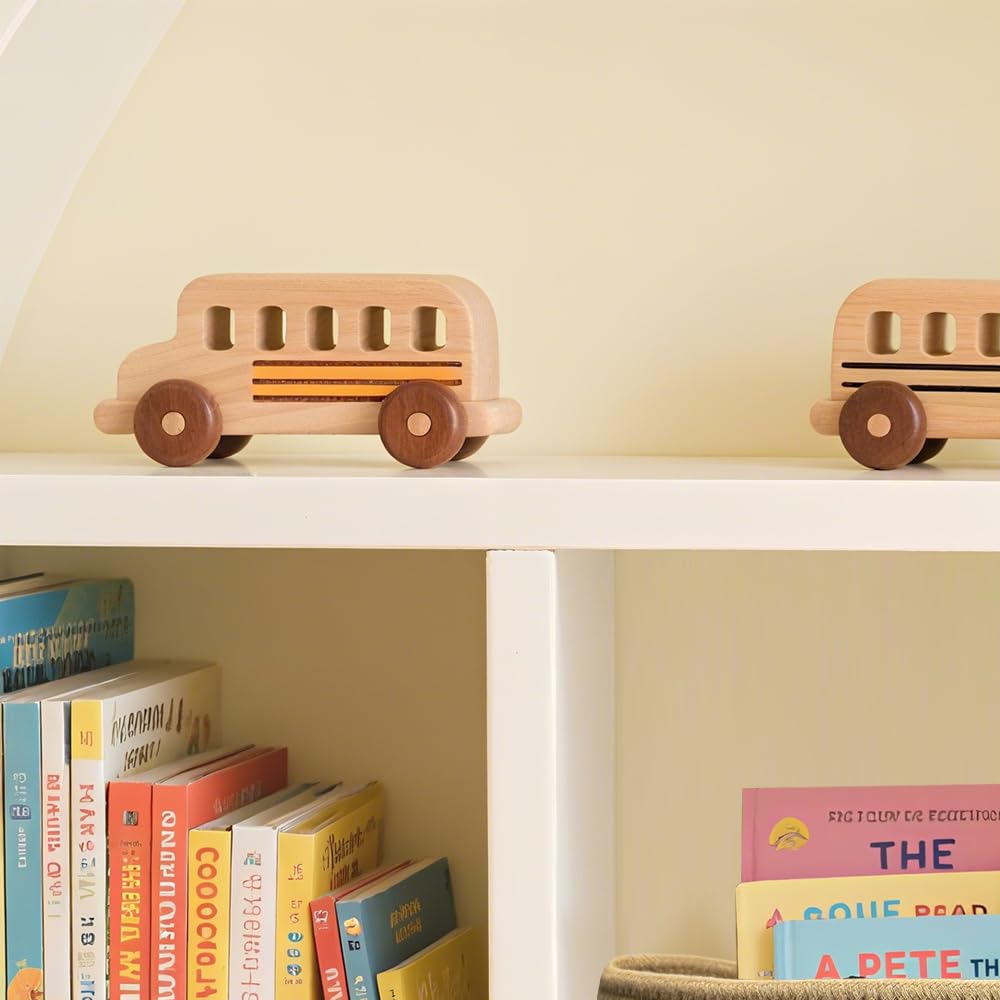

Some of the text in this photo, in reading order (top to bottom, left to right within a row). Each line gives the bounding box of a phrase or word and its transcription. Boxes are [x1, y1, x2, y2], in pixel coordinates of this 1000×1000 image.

[869, 838, 956, 870] THE
[814, 953, 841, 980] A
[857, 949, 963, 980] PETE
